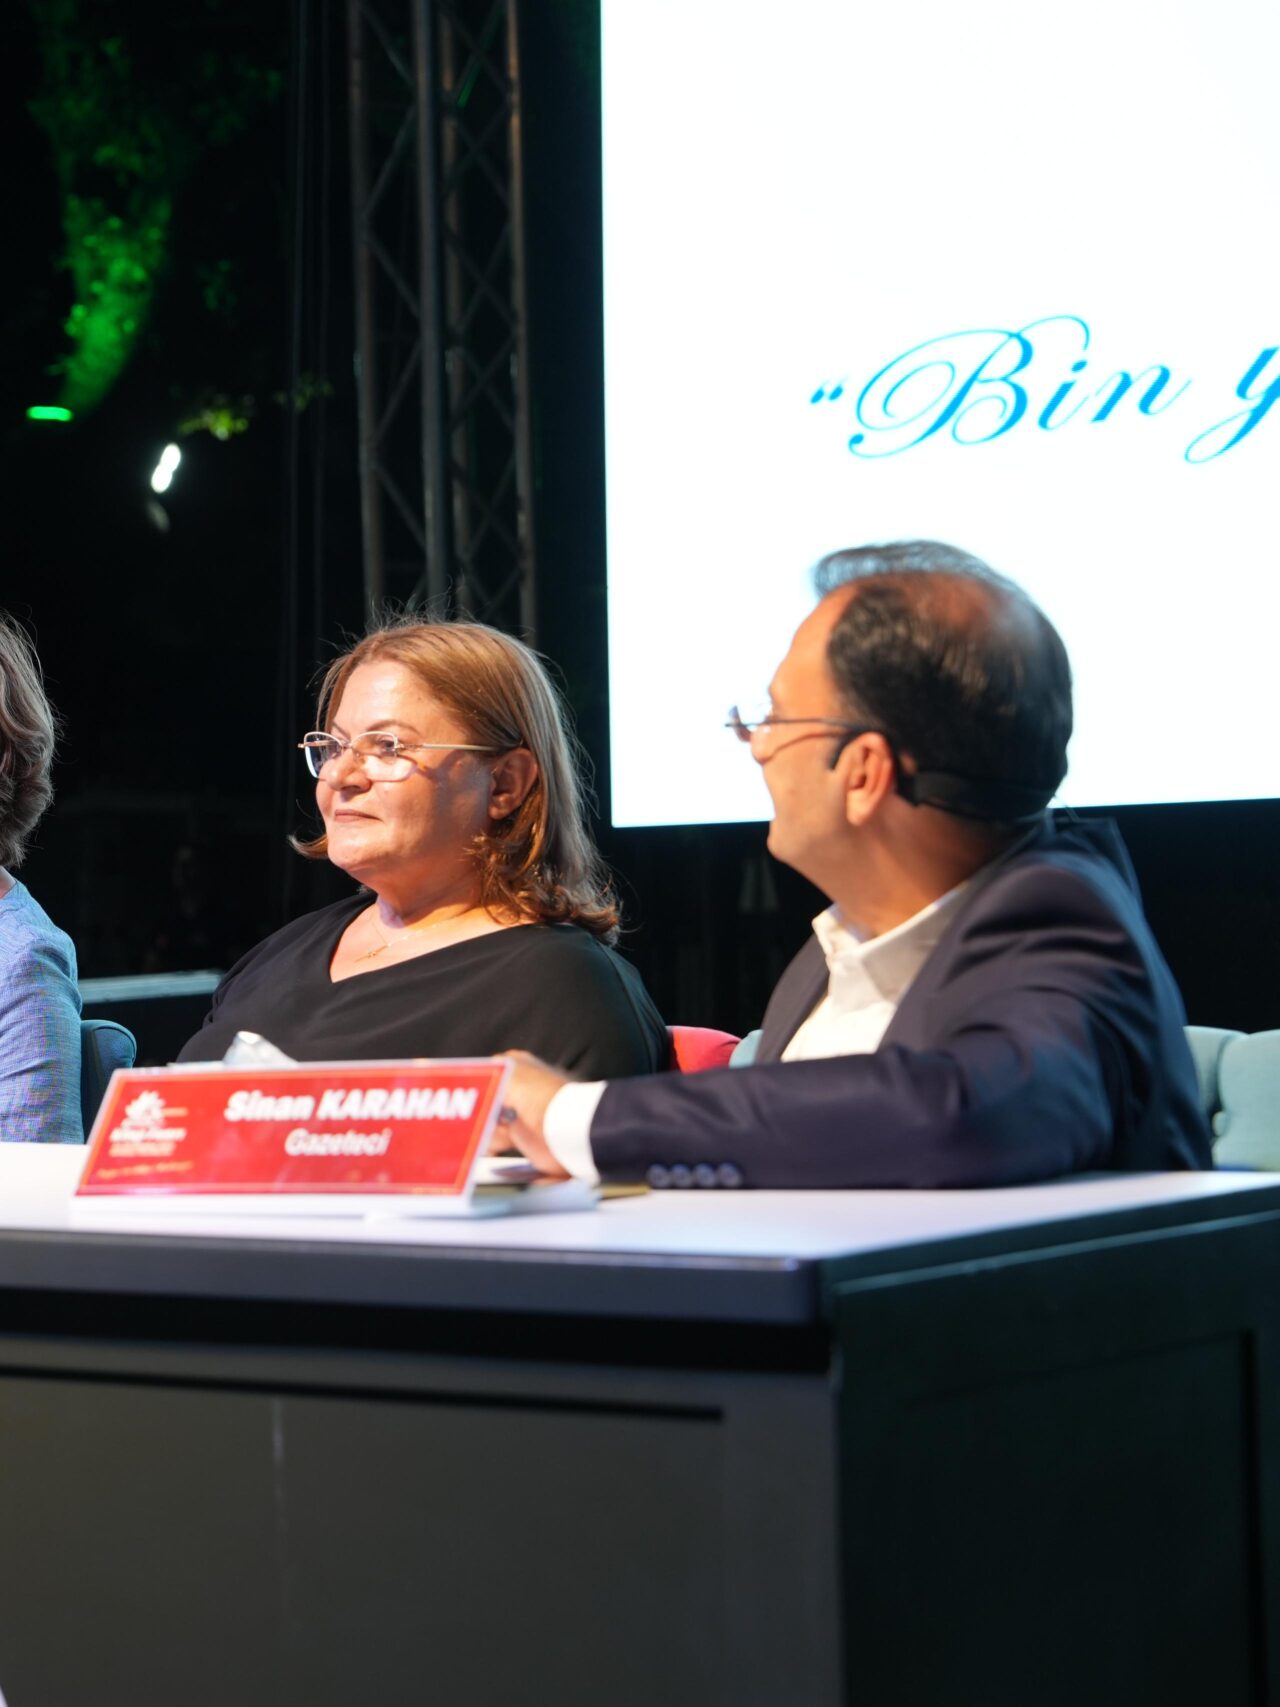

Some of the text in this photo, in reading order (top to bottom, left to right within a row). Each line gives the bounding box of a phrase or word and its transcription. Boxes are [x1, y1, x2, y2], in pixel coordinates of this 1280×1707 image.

[224, 1087, 478, 1121] Sinan KARAHAN
[284, 1127, 393, 1157] Gazeteci
